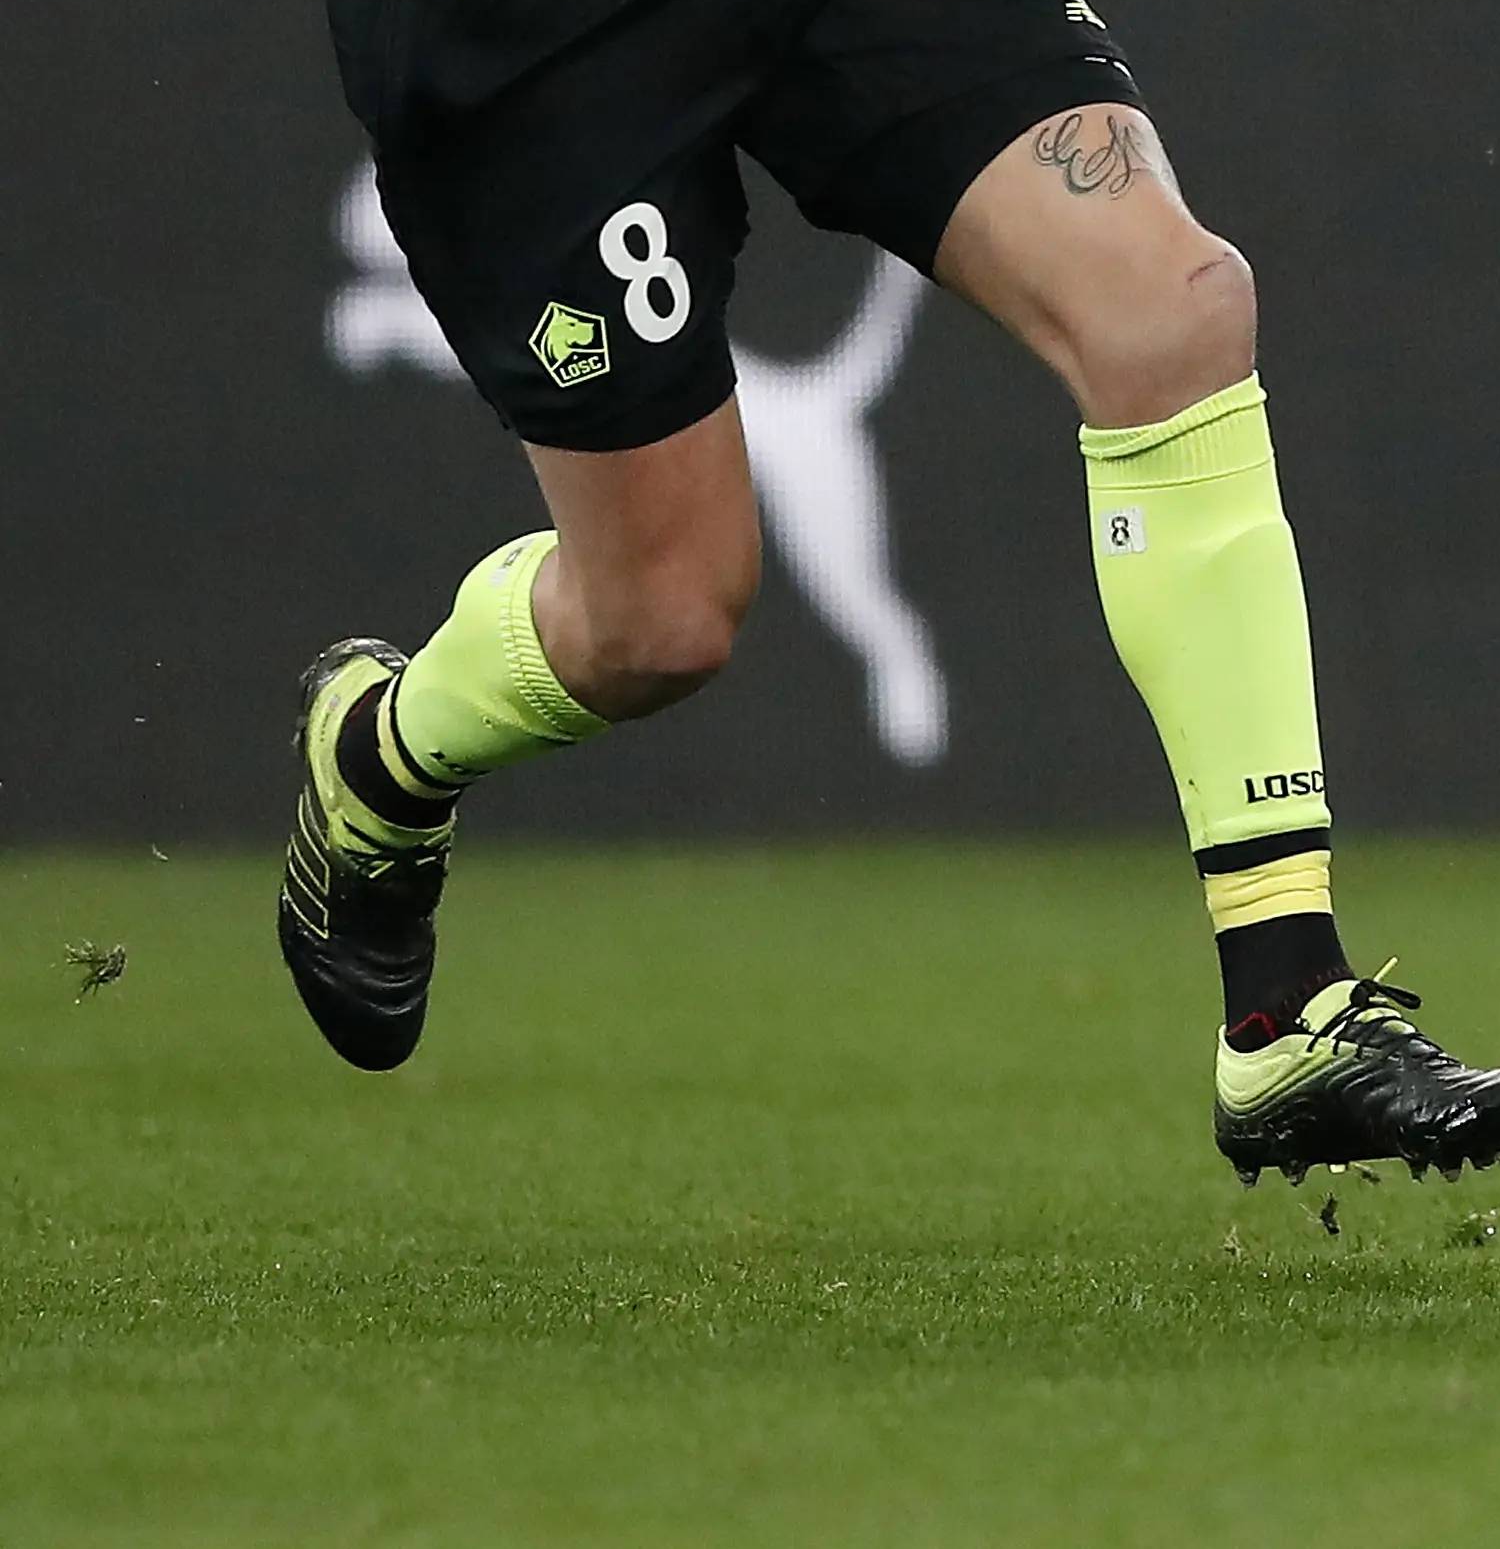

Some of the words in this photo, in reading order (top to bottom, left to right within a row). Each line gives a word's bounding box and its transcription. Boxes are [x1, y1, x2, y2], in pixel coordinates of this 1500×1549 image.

[599, 201, 691, 343] 8
[559, 355, 602, 381] LOSC
[1111, 516, 1130, 546] 8
[1244, 770, 1325, 804] LOSC
